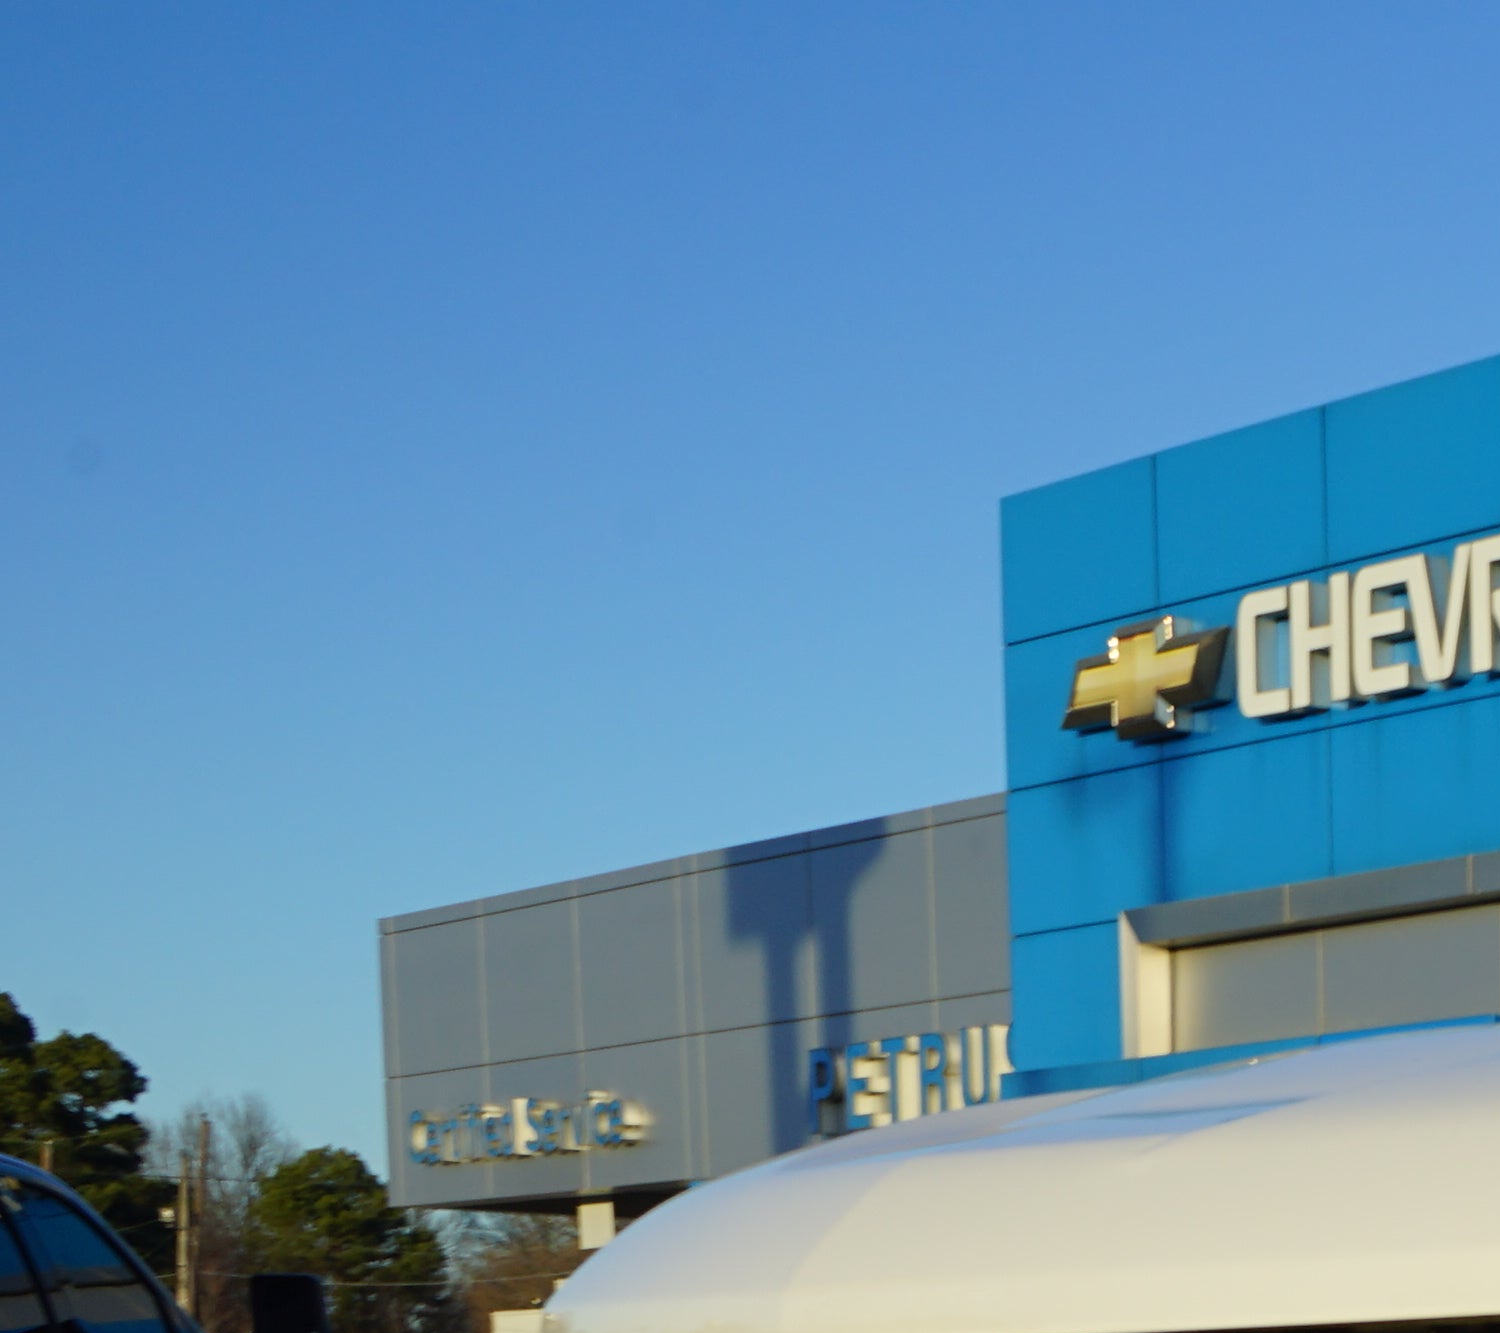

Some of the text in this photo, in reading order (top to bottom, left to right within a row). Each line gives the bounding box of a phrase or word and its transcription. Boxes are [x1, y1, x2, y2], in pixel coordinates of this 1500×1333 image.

[809, 1023, 1014, 1134] PETRU
[409, 1092, 634, 1165] Certified Service
